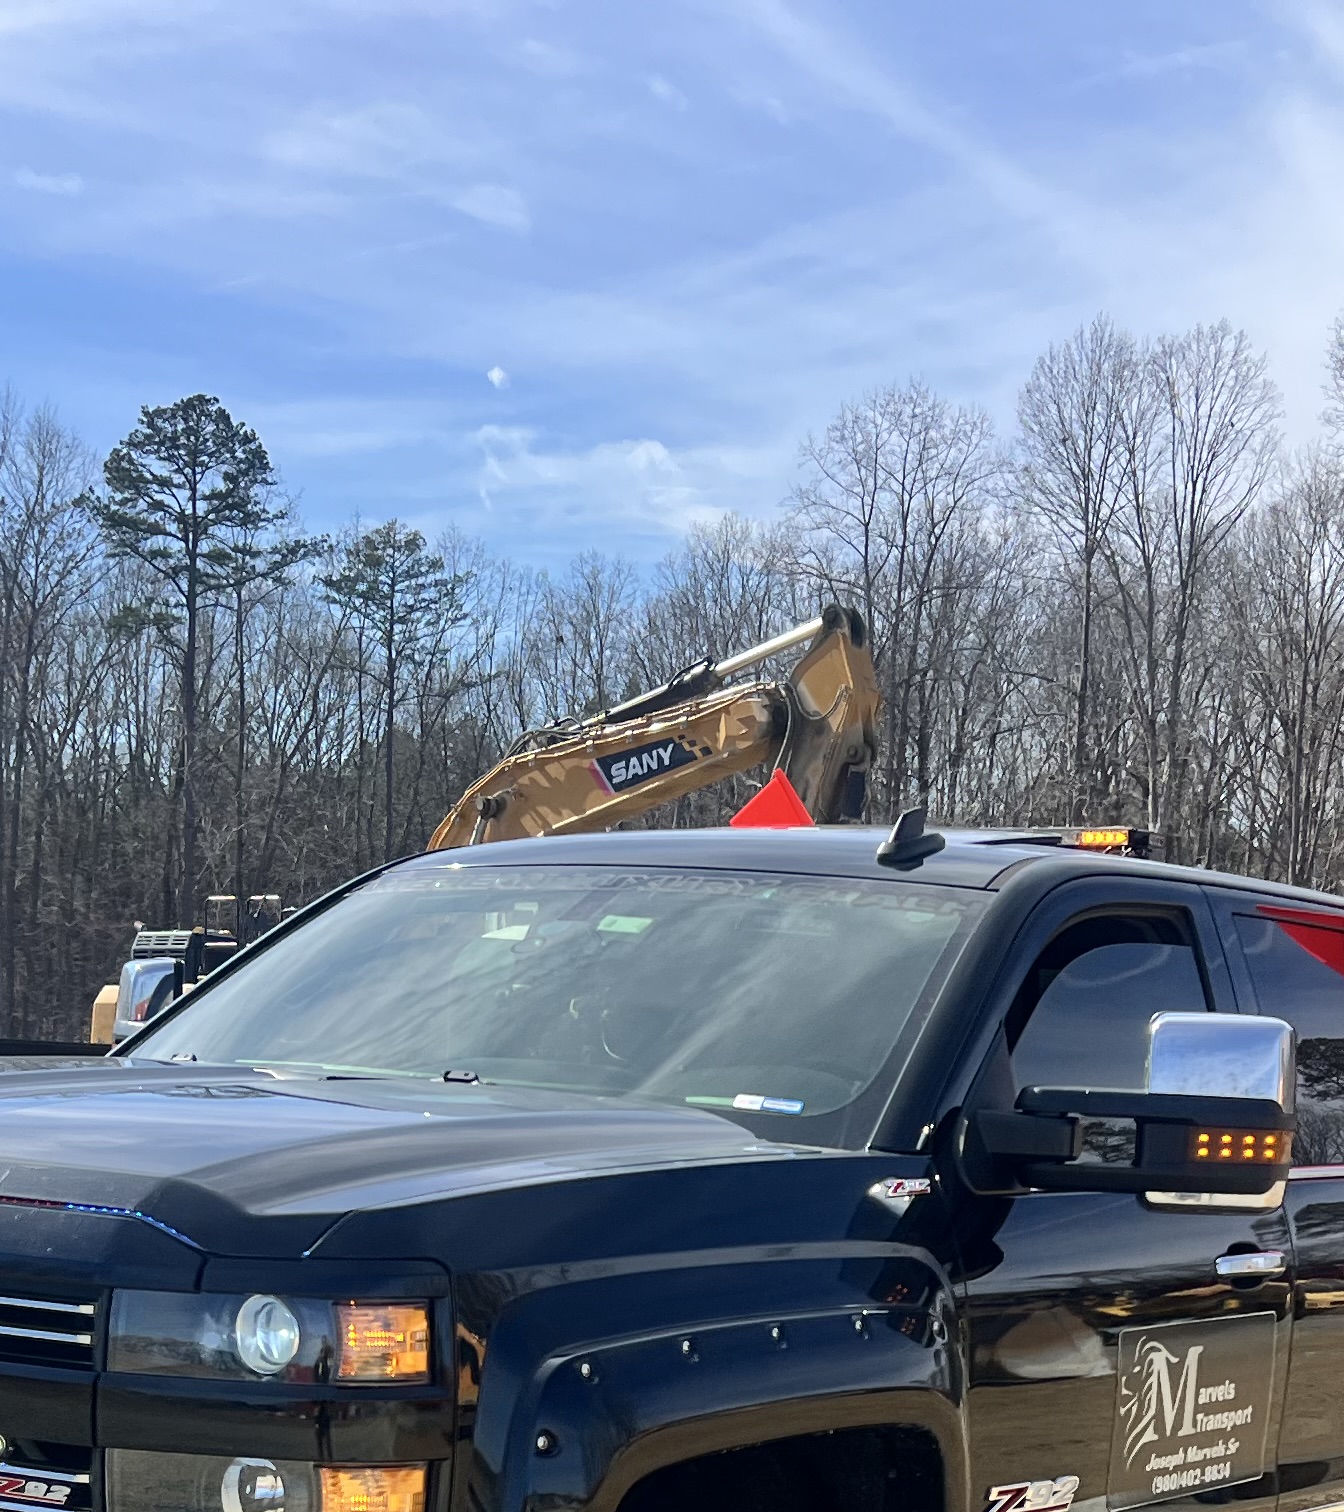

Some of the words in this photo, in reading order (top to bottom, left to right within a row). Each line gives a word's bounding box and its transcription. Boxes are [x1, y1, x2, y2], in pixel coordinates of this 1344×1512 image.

[610, 743, 675, 784] SANY
[1196, 1405, 1253, 1432] Transport
[1145, 1447, 1184, 1472] Joseph
